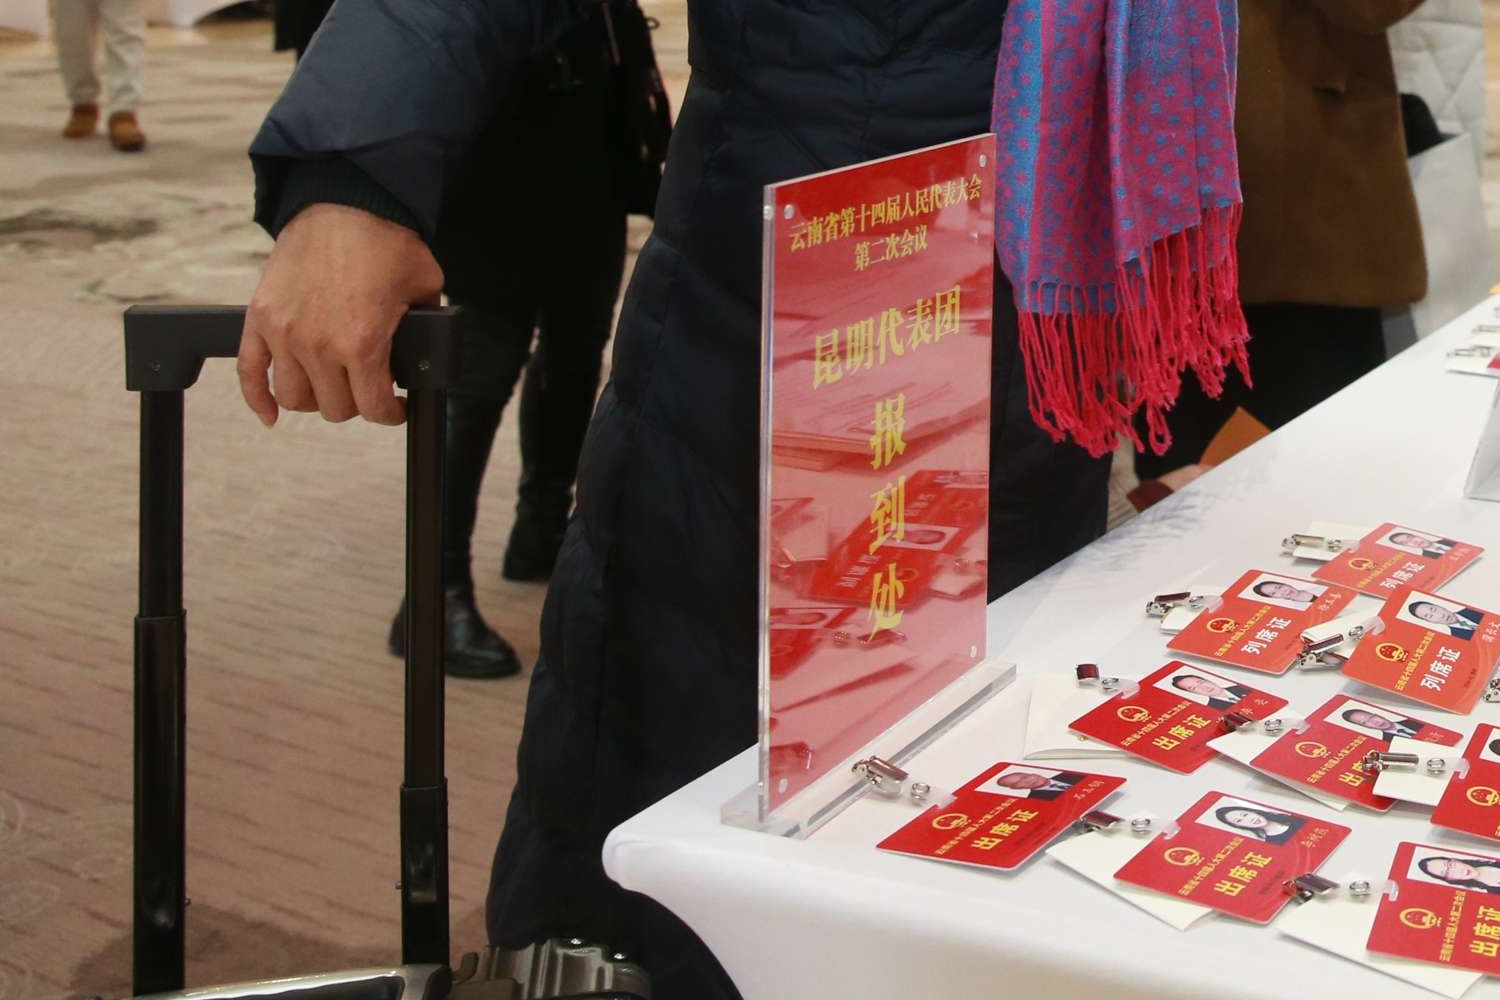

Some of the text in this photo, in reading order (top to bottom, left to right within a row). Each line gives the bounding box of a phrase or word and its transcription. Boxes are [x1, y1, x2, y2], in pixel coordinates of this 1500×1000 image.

[789, 173, 983, 252] 云南省第十四届人民代表大会
[854, 224, 929, 272] 第二次会议
[812, 284, 962, 391] 昆明代表团
[867, 392, 906, 644] 报到处
[1240, 616, 1292, 655] 列席证
[1420, 646, 1462, 692] 列席证
[1152, 713, 1212, 751] 出席证
[971, 809, 1040, 851] 出席证
[1213, 851, 1273, 897] 出席证
